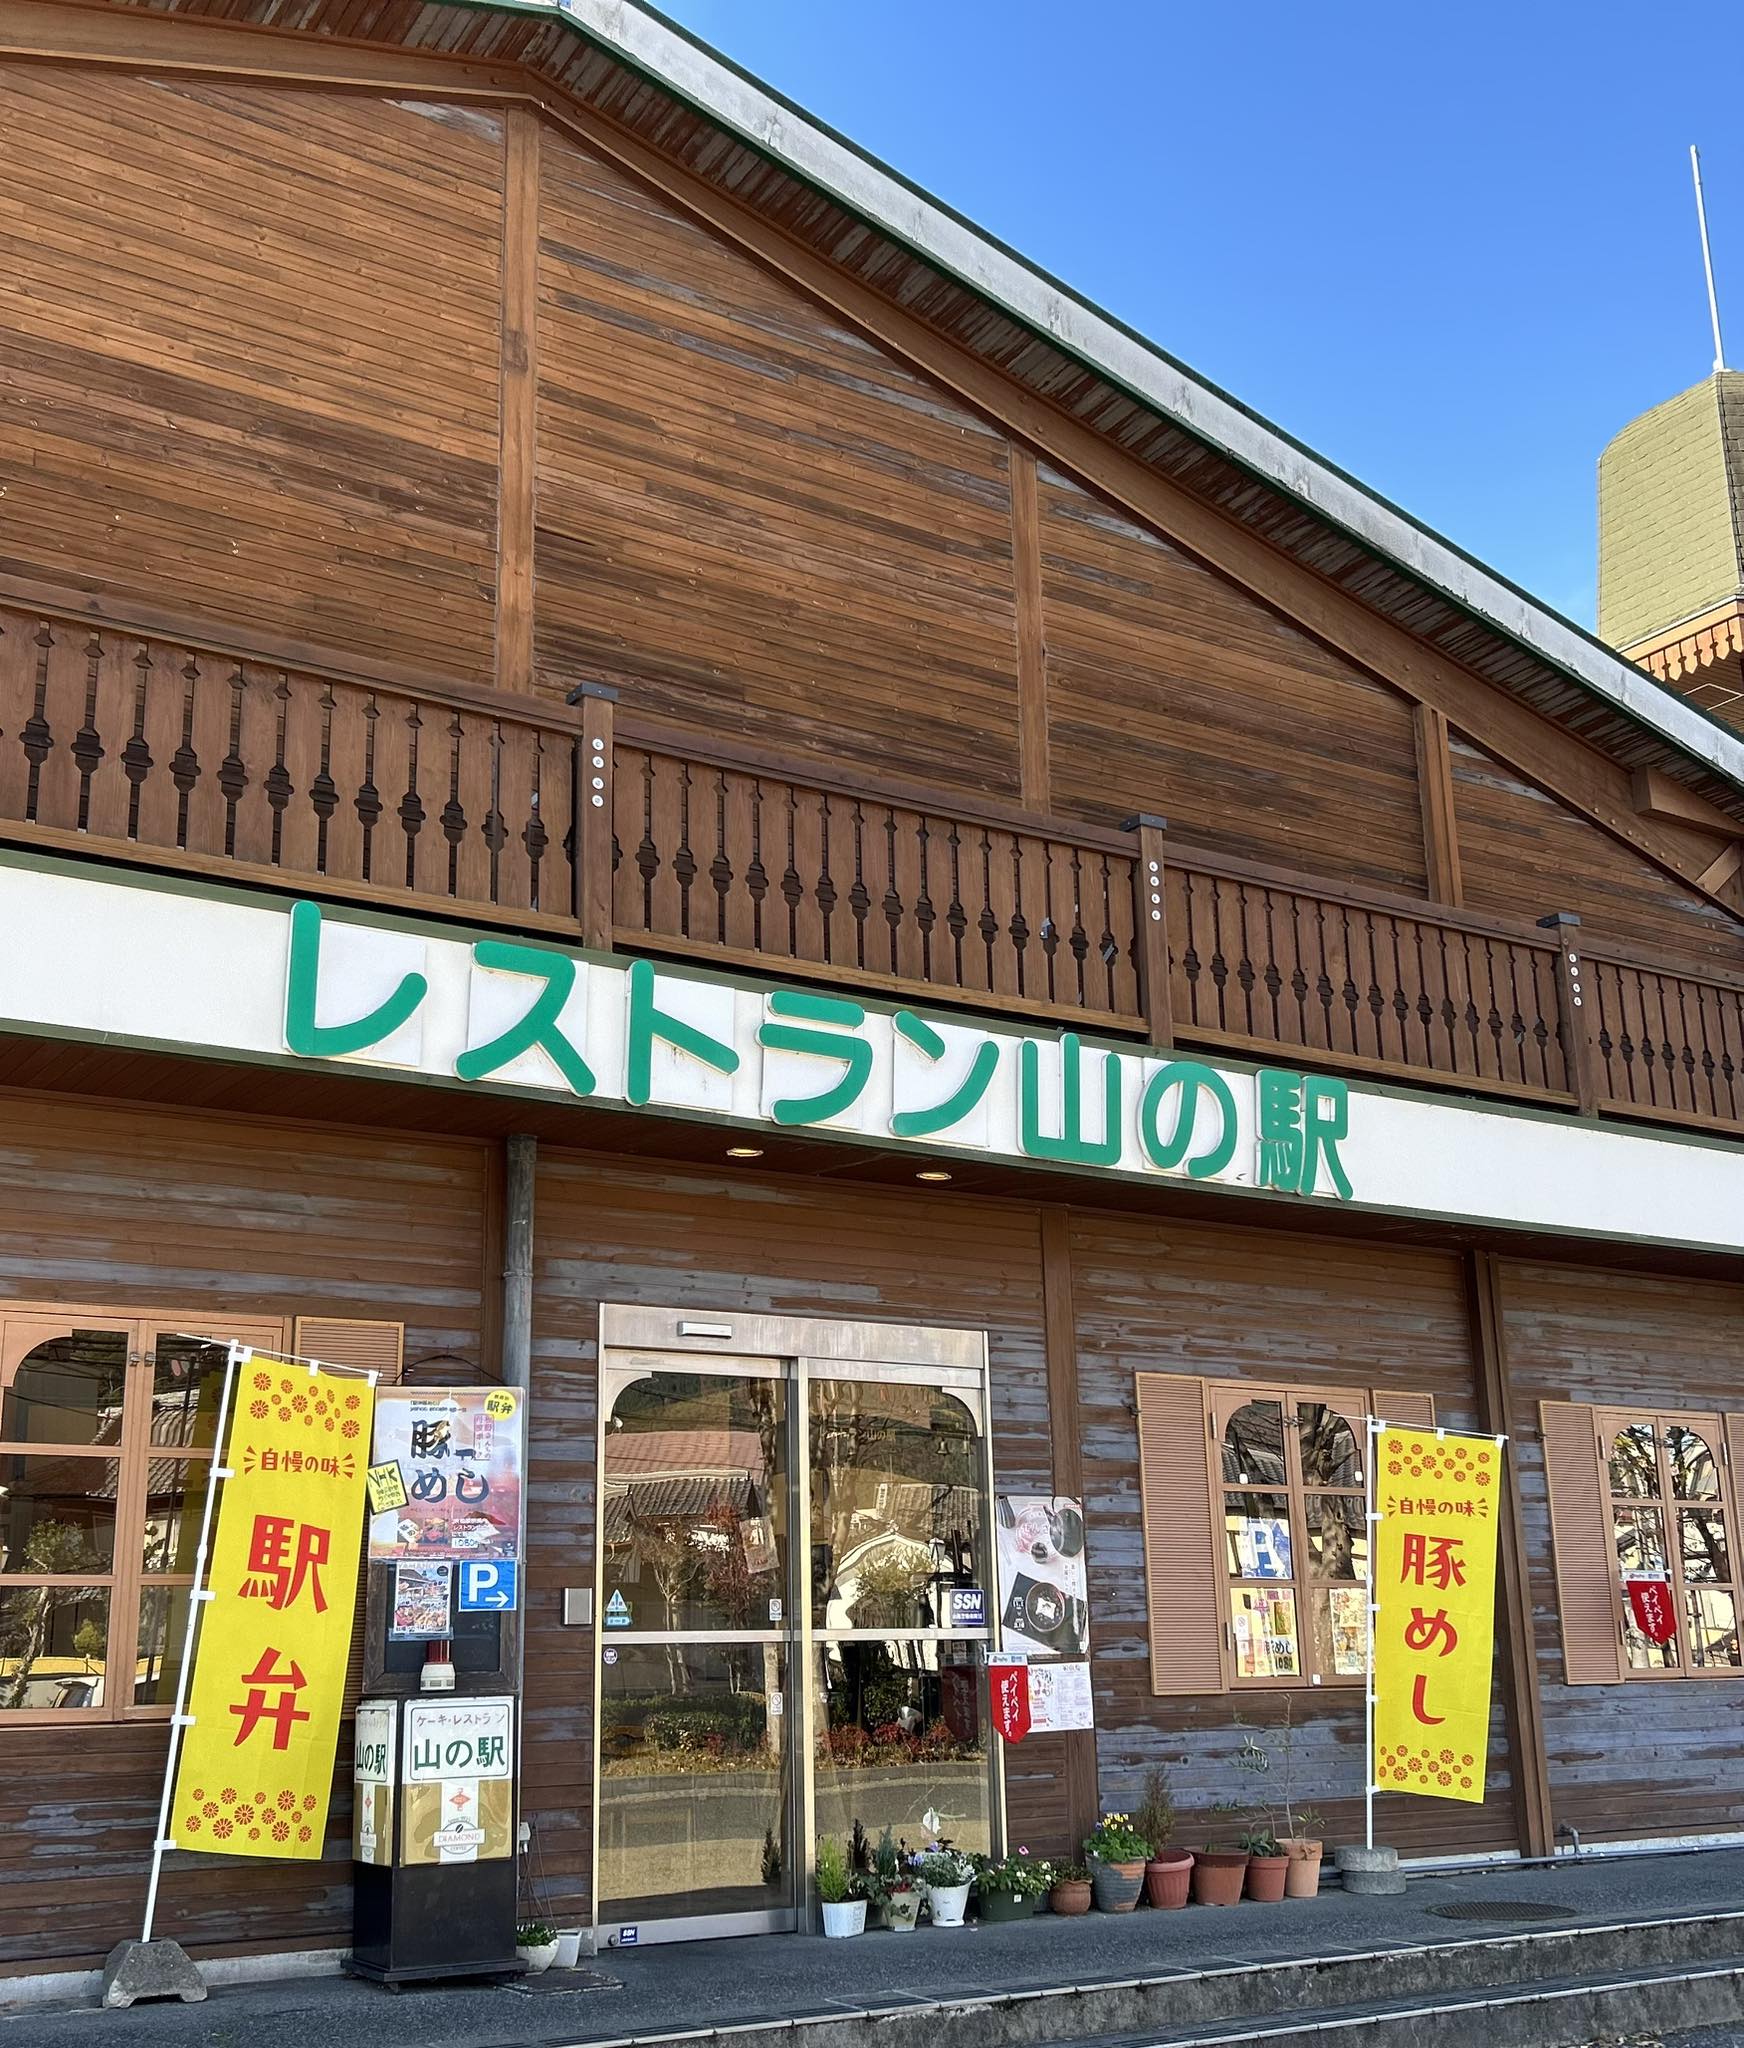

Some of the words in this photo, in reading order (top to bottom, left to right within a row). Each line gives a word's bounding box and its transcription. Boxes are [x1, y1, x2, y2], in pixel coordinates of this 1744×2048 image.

[286, 900, 1353, 1201] レストラン山の駅
[261, 1448, 340, 1478] 自慢の味
[1401, 1497, 1475, 1517] 自慢の味
[469, 1564, 499, 1602] P
[953, 1593, 982, 1610] SSN
[1648, 1585, 1663, 1625] ペイペイ
[230, 1514, 330, 1751] 駅弁
[1400, 1533, 1466, 1725] 豚めし
[1000, 1679, 1012, 1737] 使えます。
[1009, 1670, 1019, 1722] ペイペイ
[416, 1712, 505, 1727] ケーキ・レストラン
[355, 1740, 387, 1775] 山の駅
[414, 1735, 506, 1771] 山の駅
[438, 1833, 481, 1843] DIAMOND
